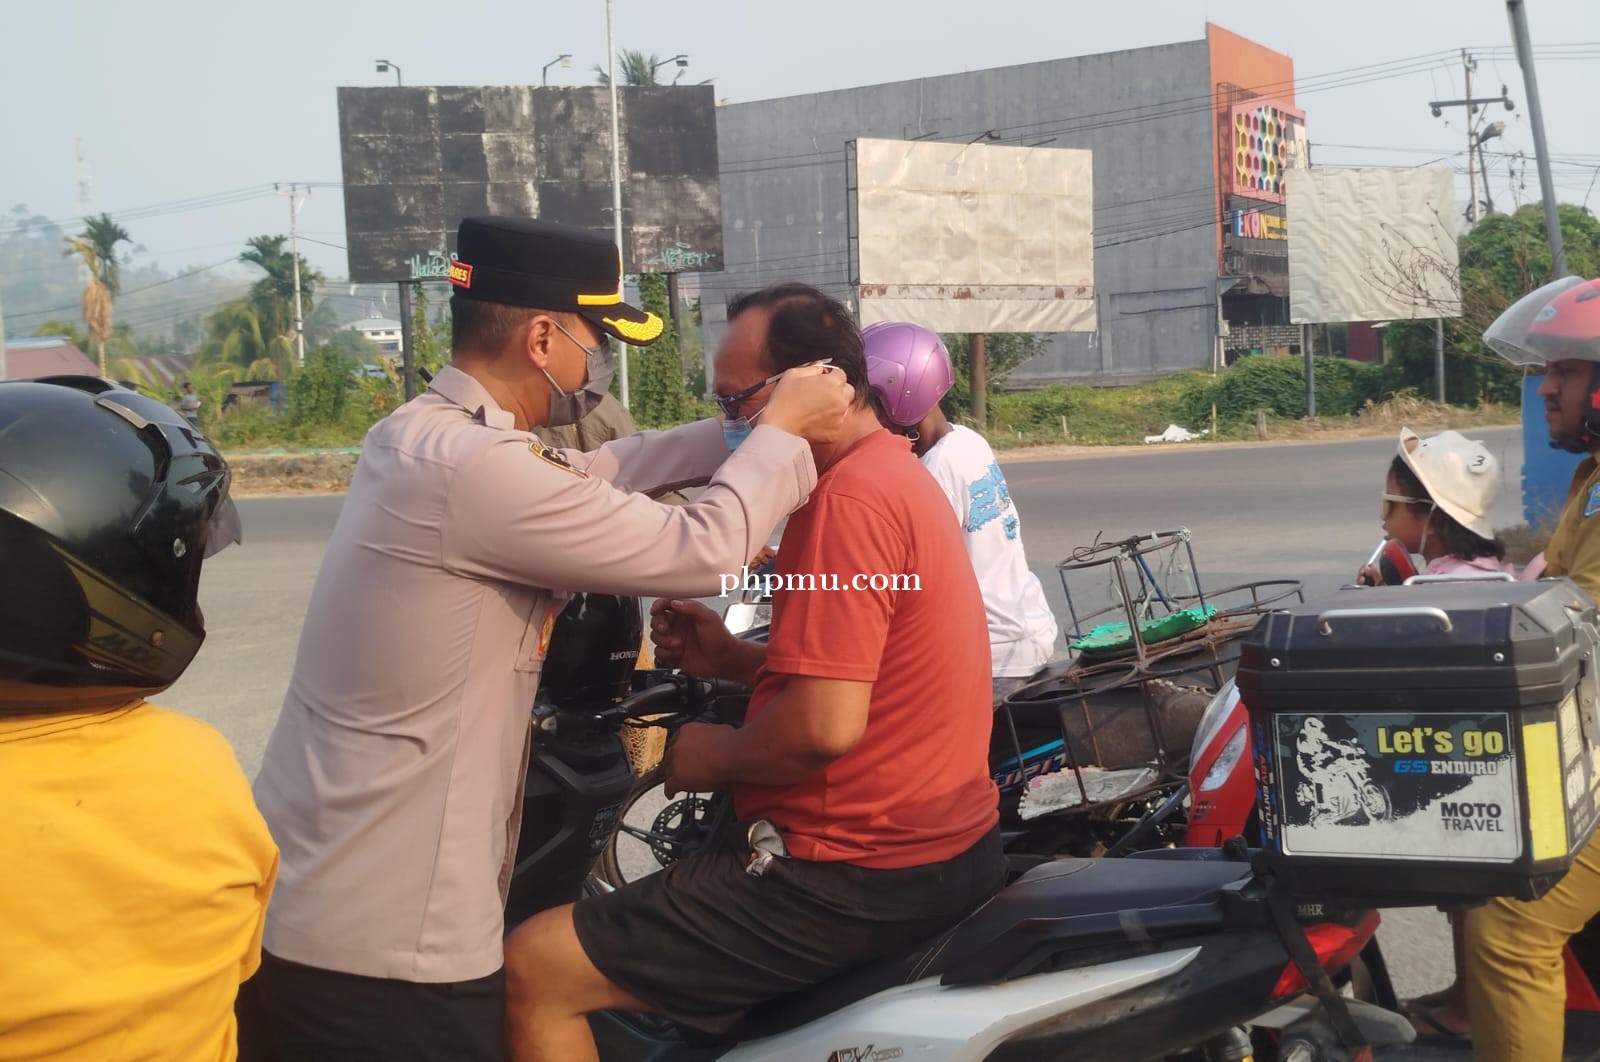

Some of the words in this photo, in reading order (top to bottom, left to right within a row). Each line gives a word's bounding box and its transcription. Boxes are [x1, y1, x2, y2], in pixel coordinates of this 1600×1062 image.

[1377, 727, 1454, 754] Let's
[1463, 730, 1504, 756] go
[1393, 759, 1428, 774] GS
[1430, 760, 1498, 775] ENDURO
[1440, 802, 1502, 818] MOTO
[1441, 818, 1504, 832] TRAVEL
